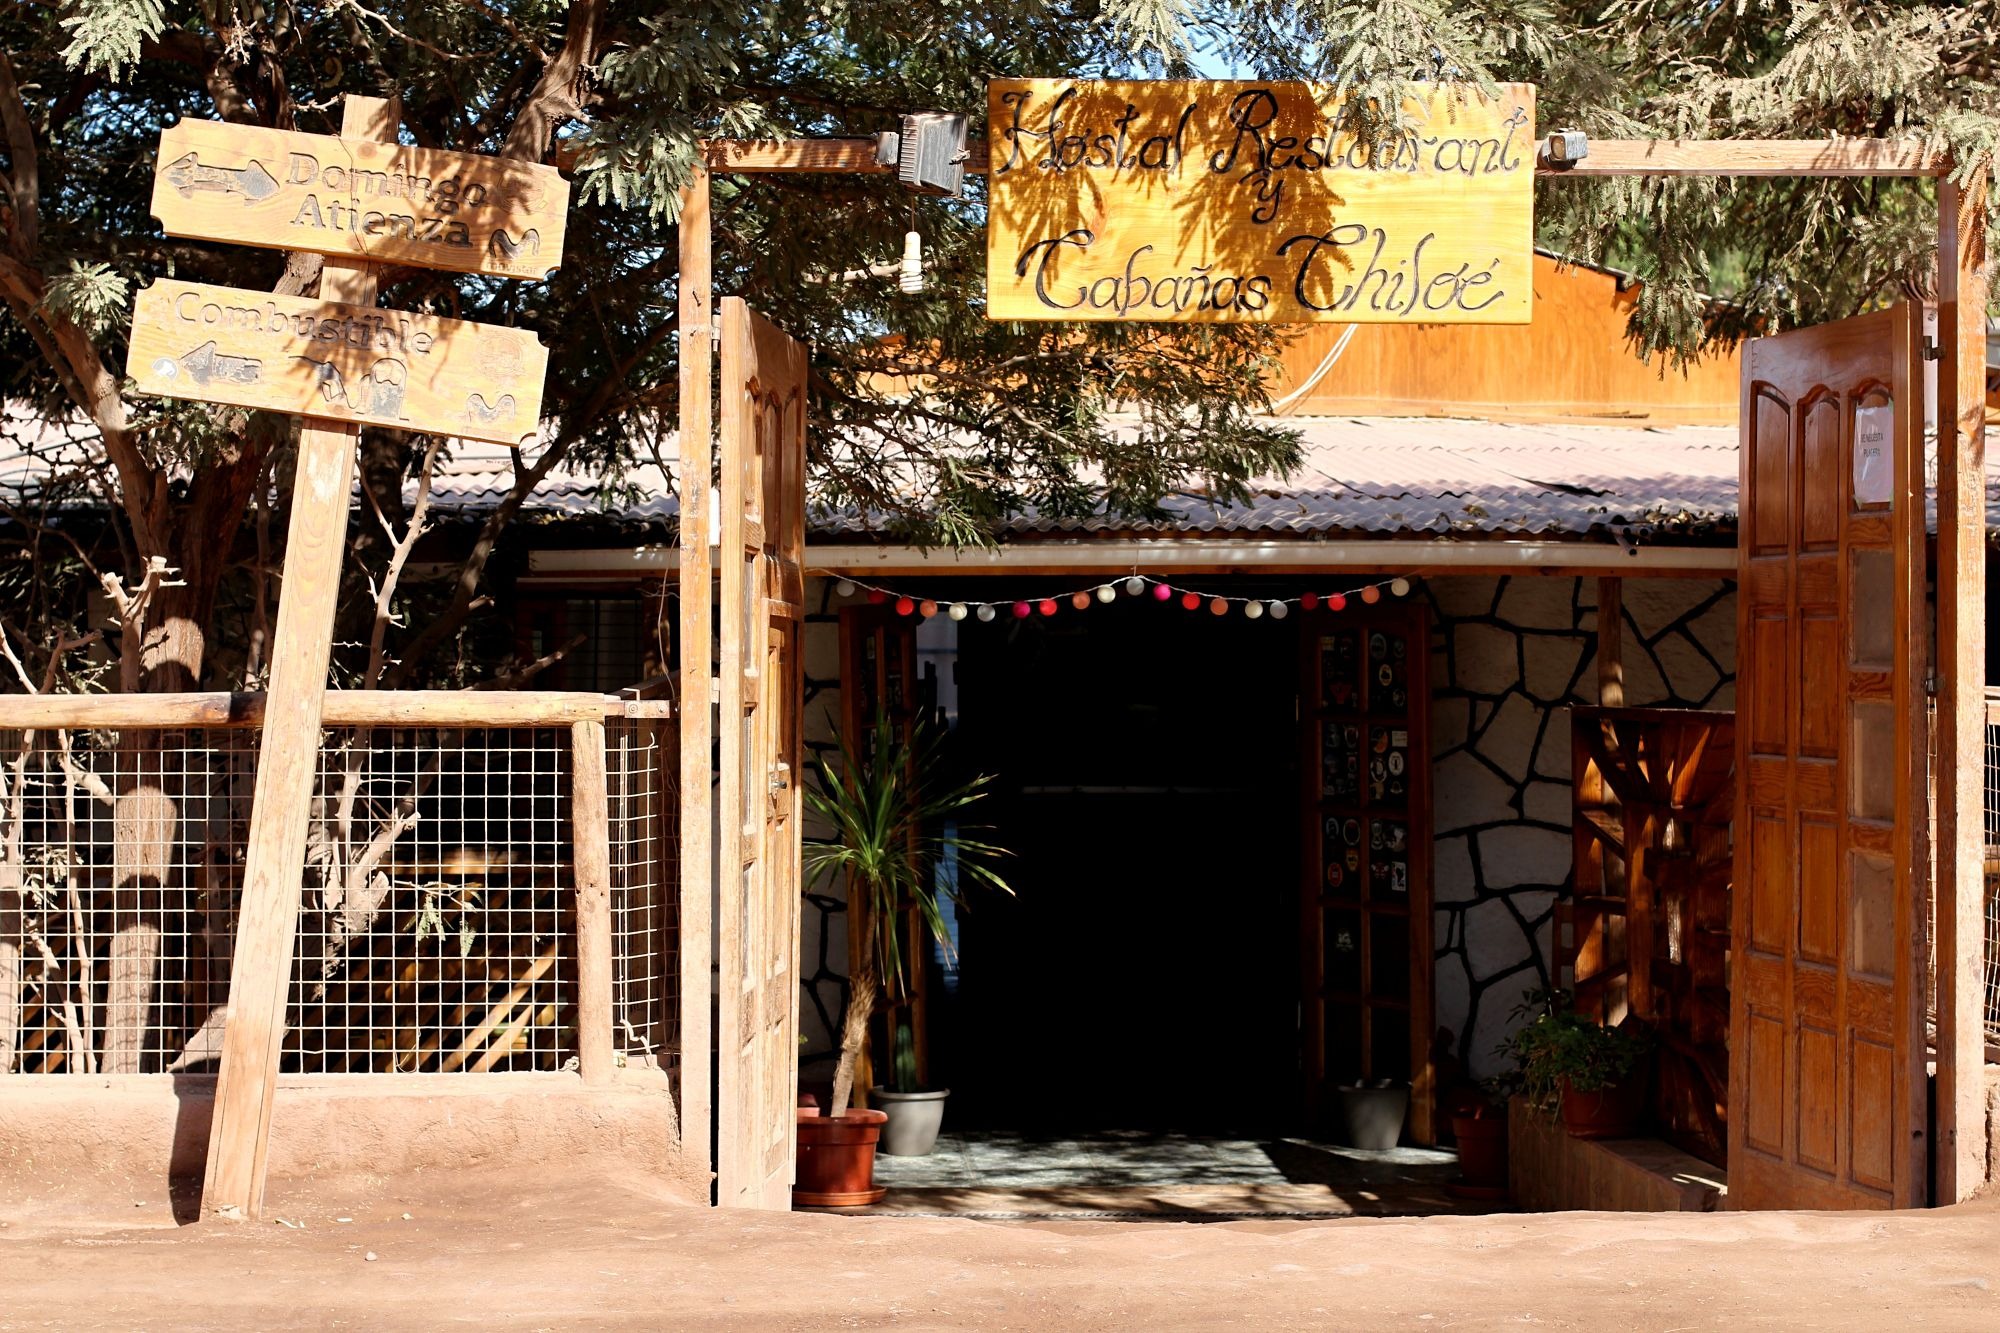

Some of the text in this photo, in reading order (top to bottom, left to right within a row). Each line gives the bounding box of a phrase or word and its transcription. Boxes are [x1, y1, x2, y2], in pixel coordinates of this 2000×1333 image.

[994, 87, 1529, 177] Hostal Restaurant
[285, 151, 487, 216] Domingo
[1239, 168, 1284, 225] y
[289, 193, 473, 248] Atienza
[1014, 223, 1506, 317] Cabañas Chiloé
[173, 291, 434, 356] Combustible
